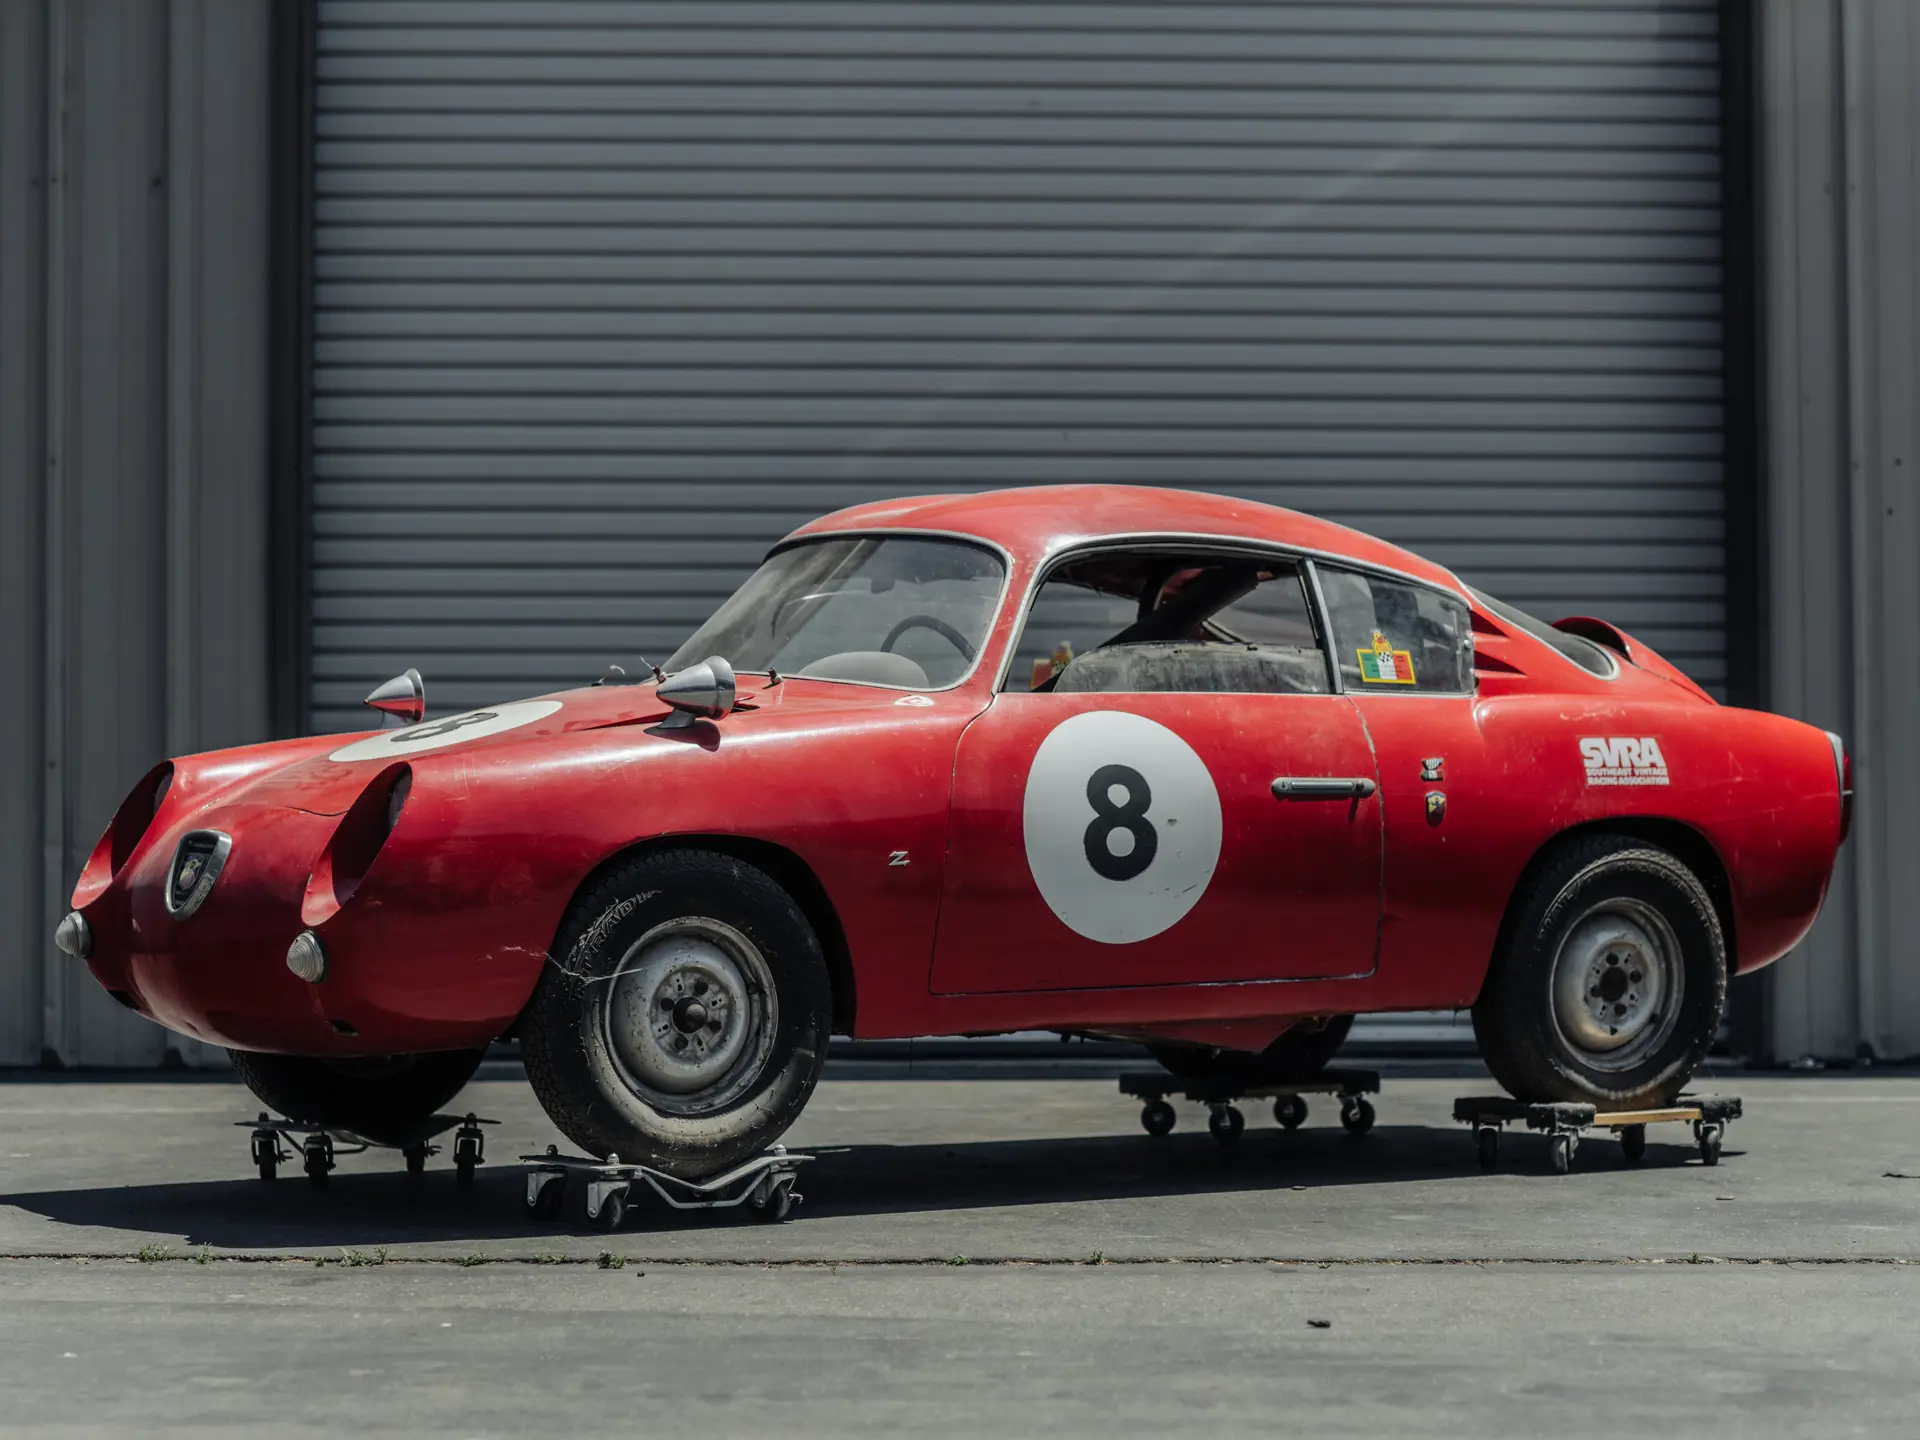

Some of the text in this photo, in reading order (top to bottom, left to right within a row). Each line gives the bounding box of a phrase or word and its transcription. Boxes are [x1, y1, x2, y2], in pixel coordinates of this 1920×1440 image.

[390, 712, 499, 742] 8
[1579, 737, 1666, 768] SVRA
[1084, 764, 1158, 881] 8
[889, 851, 910, 866] Z
